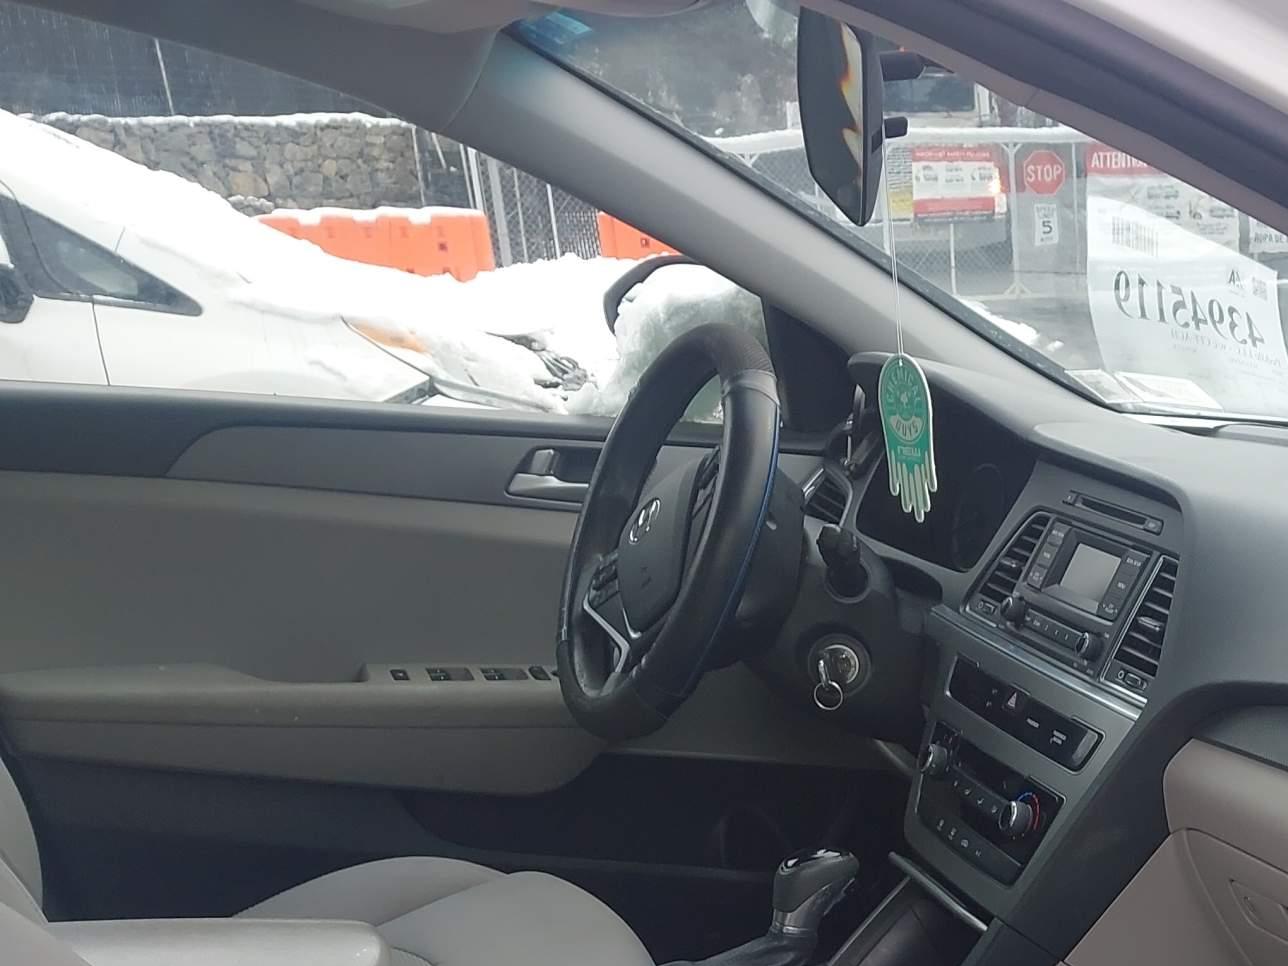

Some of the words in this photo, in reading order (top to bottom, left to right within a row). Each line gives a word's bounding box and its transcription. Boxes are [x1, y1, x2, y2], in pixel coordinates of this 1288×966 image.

[1091, 152, 1148, 169] ATTENTI
[1026, 164, 1062, 183] STOP
[1042, 220, 1053, 235] 5
[895, 419, 918, 440] GUYS
